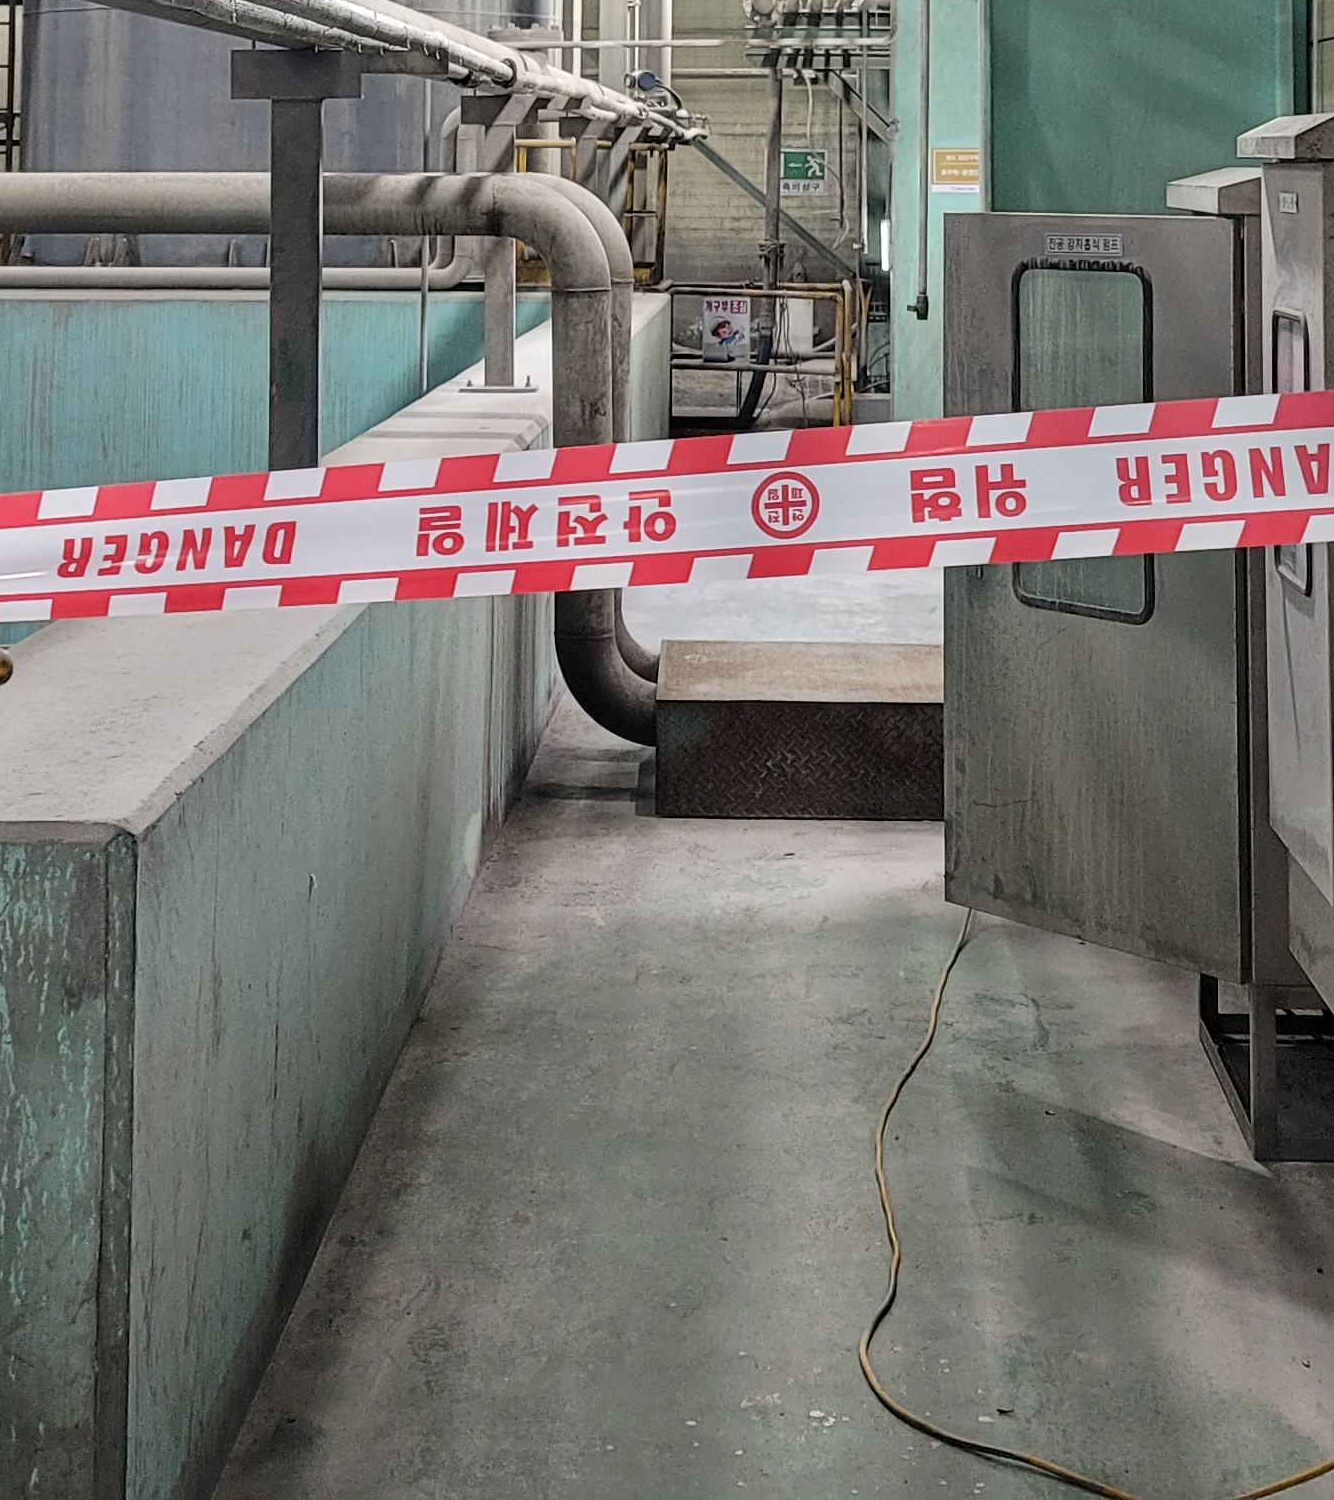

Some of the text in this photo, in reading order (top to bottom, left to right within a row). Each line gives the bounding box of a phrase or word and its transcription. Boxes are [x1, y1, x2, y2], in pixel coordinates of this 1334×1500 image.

[415, 489, 678, 557] 안전제일
[909, 463, 1028, 524] 위험
[56, 520, 297, 579] DANGER
